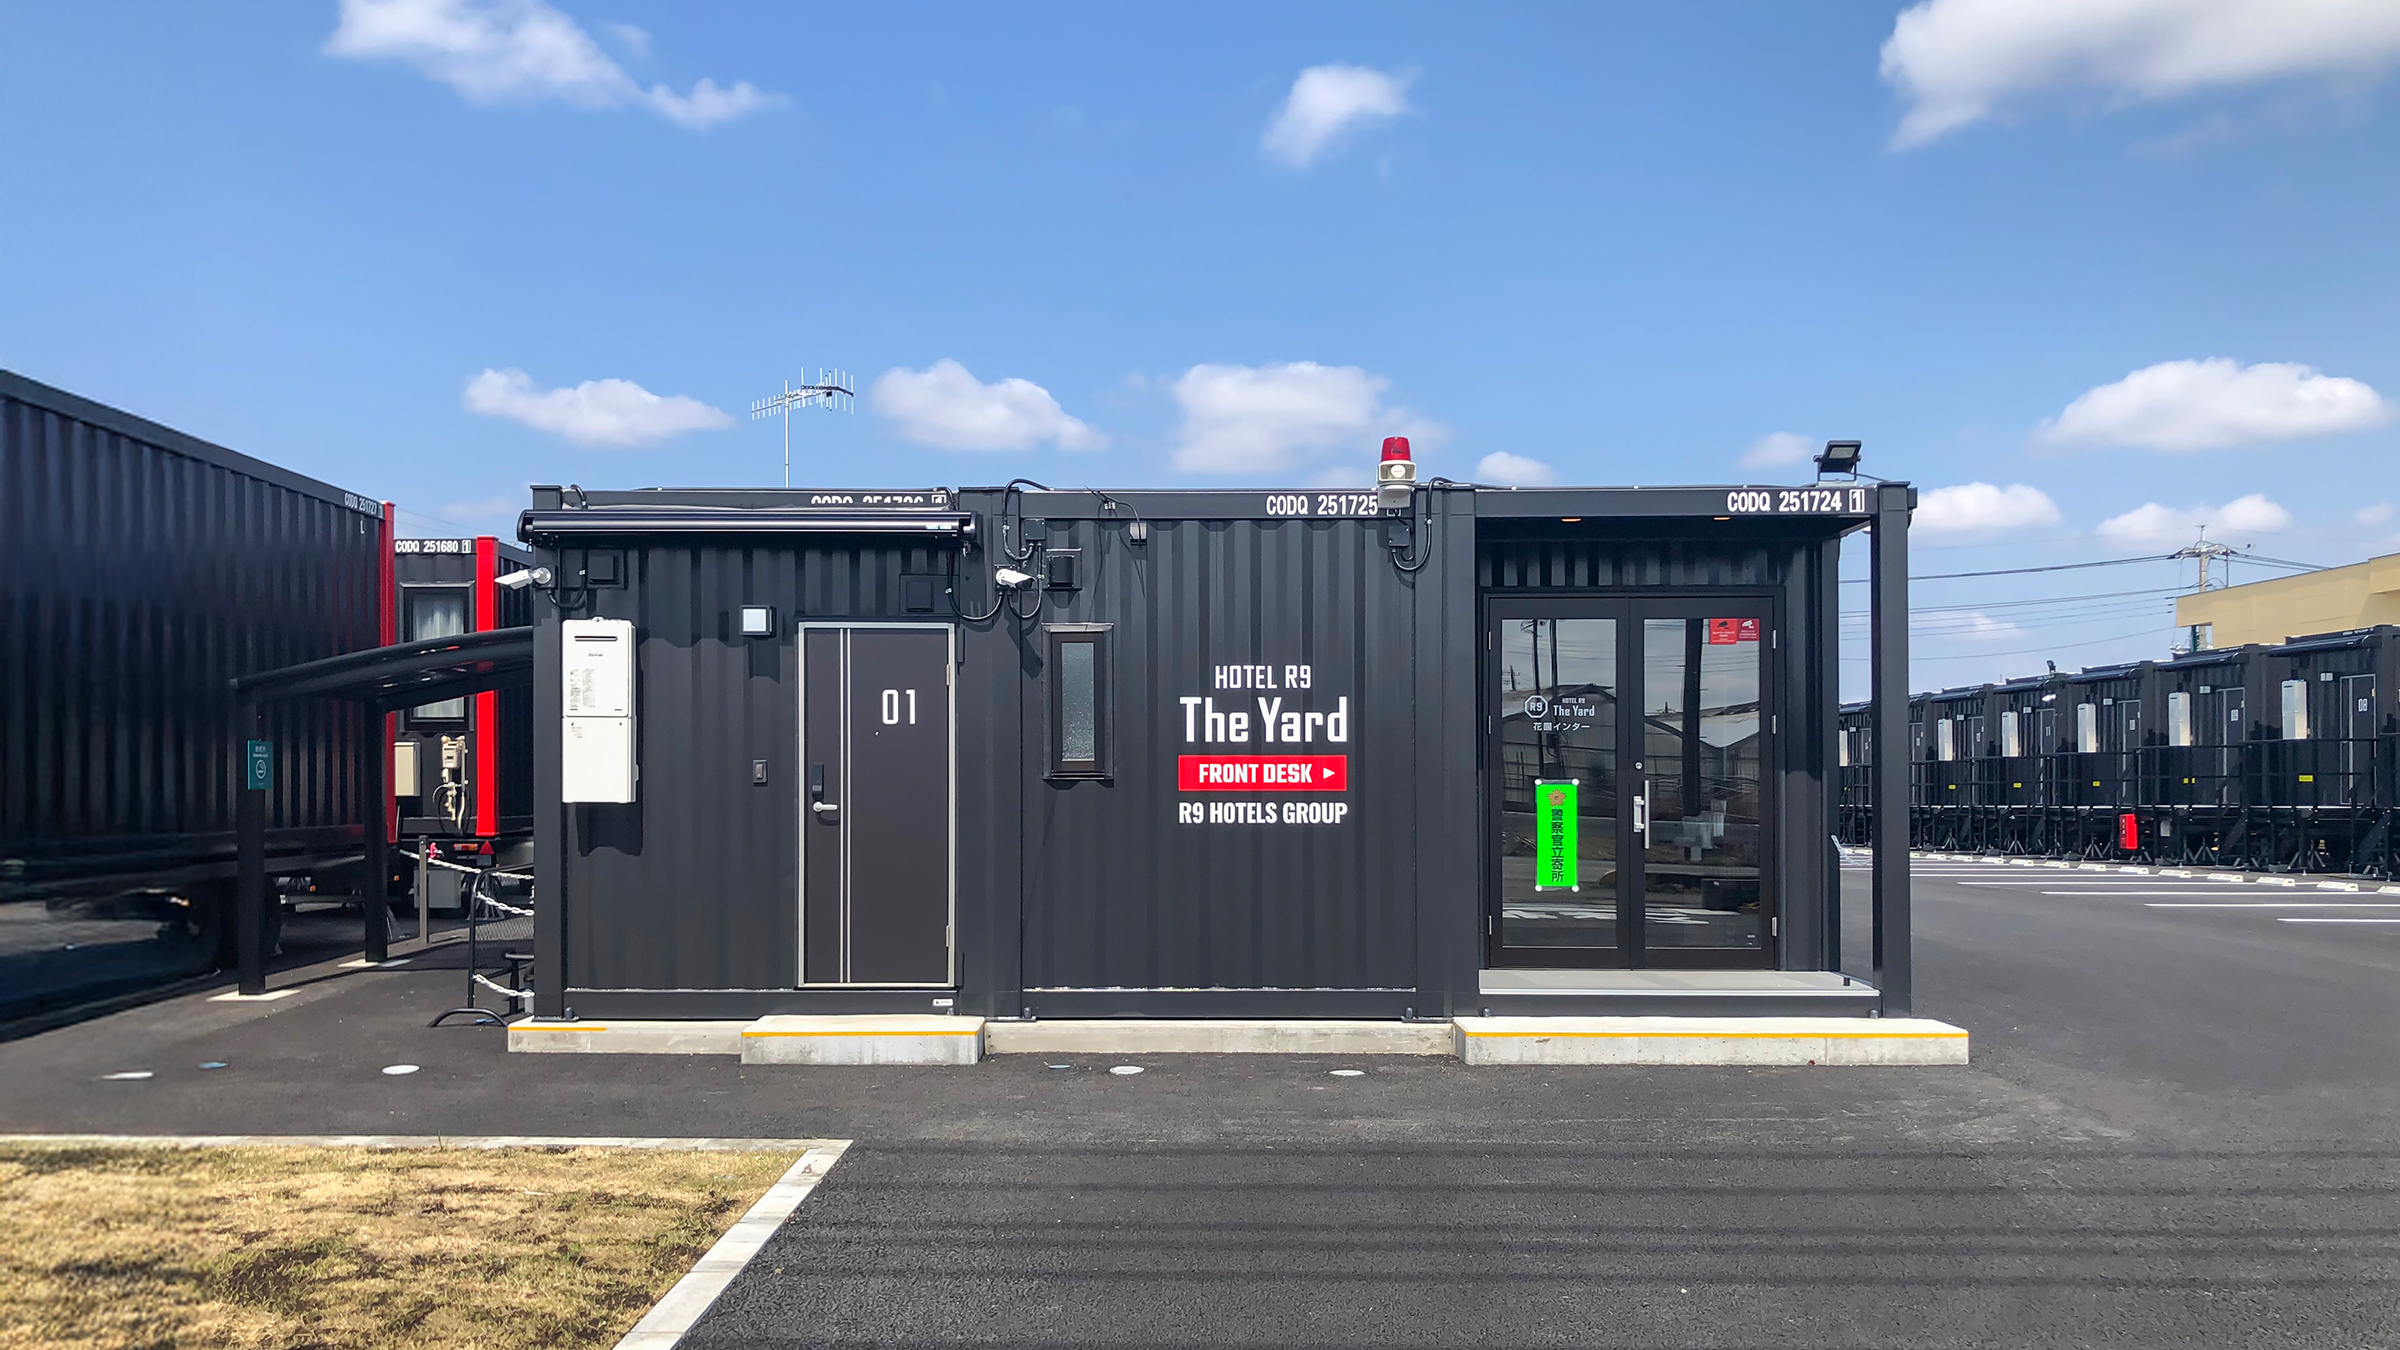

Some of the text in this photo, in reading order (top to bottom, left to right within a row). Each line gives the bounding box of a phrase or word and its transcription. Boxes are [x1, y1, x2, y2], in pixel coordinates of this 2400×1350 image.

[1266, 495, 1378, 516] CODQ 251725
[1727, 490, 1863, 512] CODQ 251724 1
[395, 540, 420, 553] CODQ
[423, 540, 459, 553] 251680
[1215, 665, 1311, 689] HOTEL R9
[882, 689, 916, 725] 01
[1529, 702, 1543, 712] R9
[1553, 705, 1595, 717] The Yard
[1179, 696, 1347, 742] The Yard
[1199, 763, 1312, 783] FRONT DESK
[1178, 802, 1348, 824] R9 HOTELS GROUP
